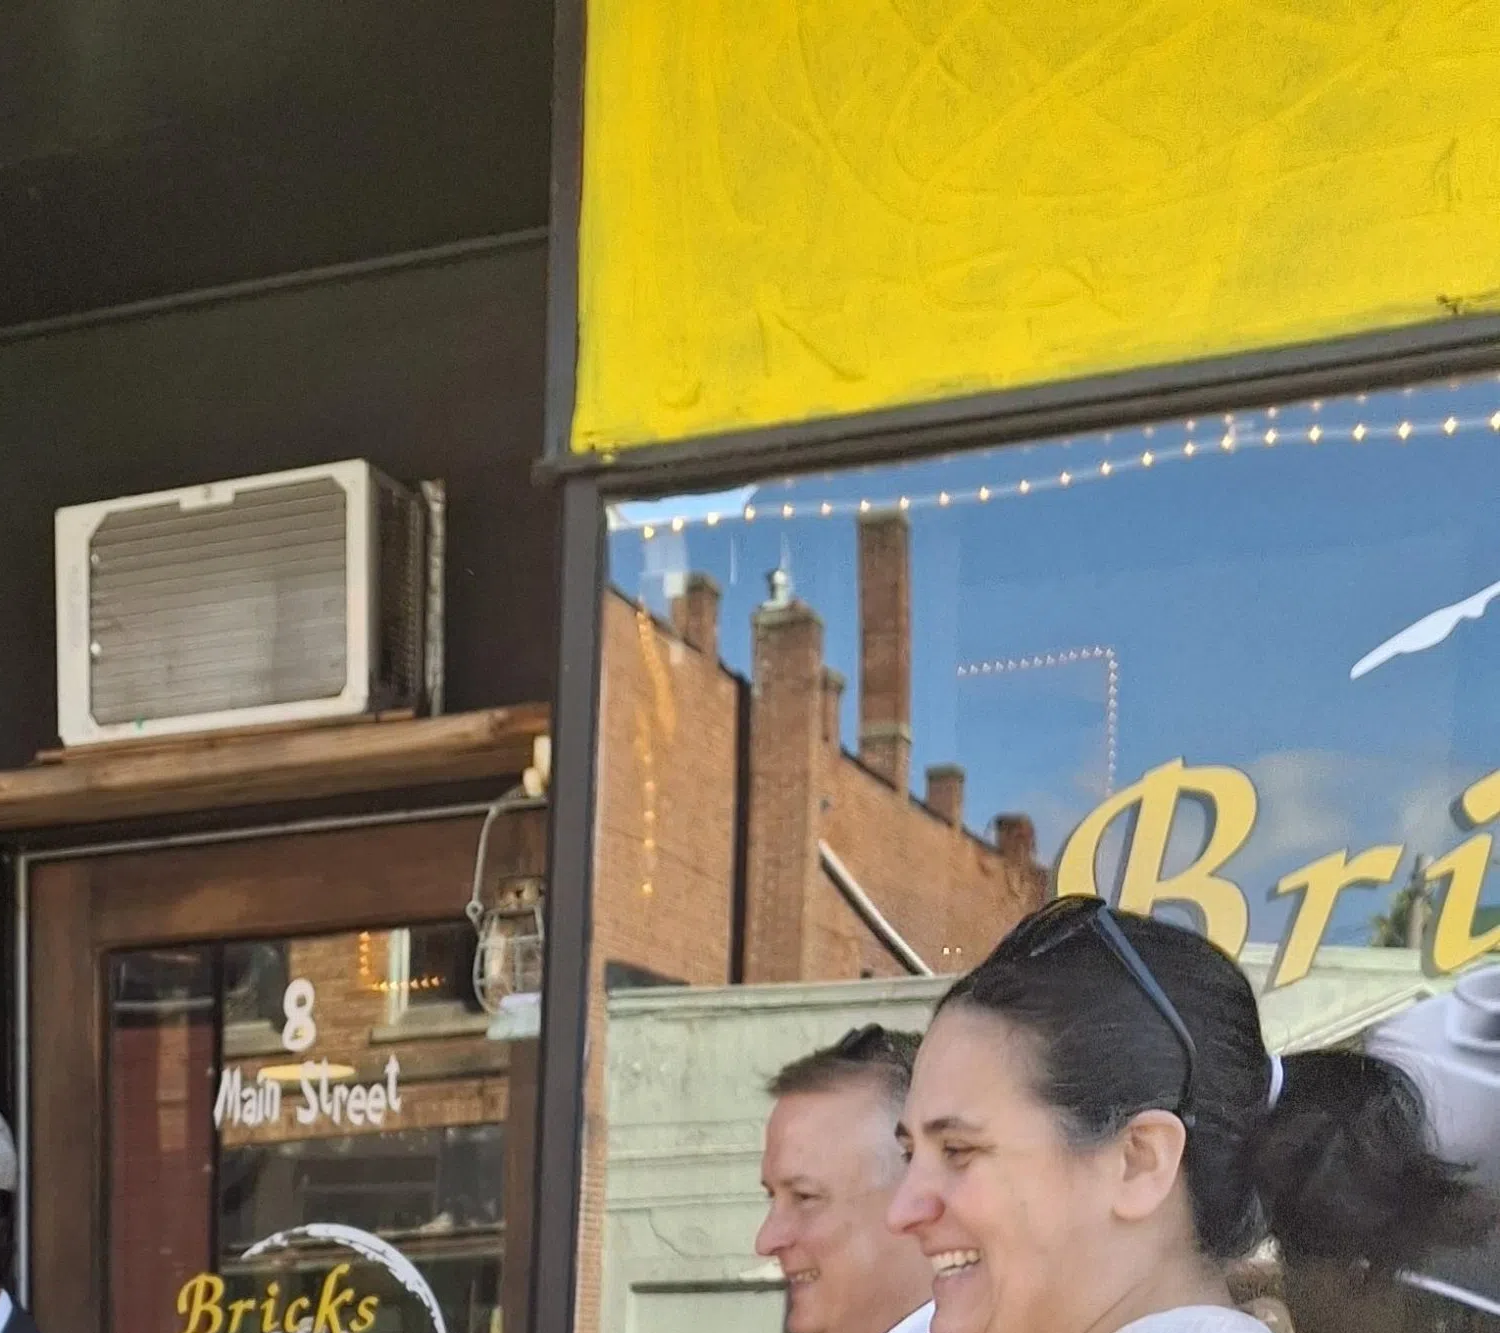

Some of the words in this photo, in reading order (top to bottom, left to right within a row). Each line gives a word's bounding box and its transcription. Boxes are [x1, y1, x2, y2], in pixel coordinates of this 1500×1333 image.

[281, 977, 317, 1052] 8
[213, 1064, 282, 1130] Main
[296, 1053, 402, 1126] Street
